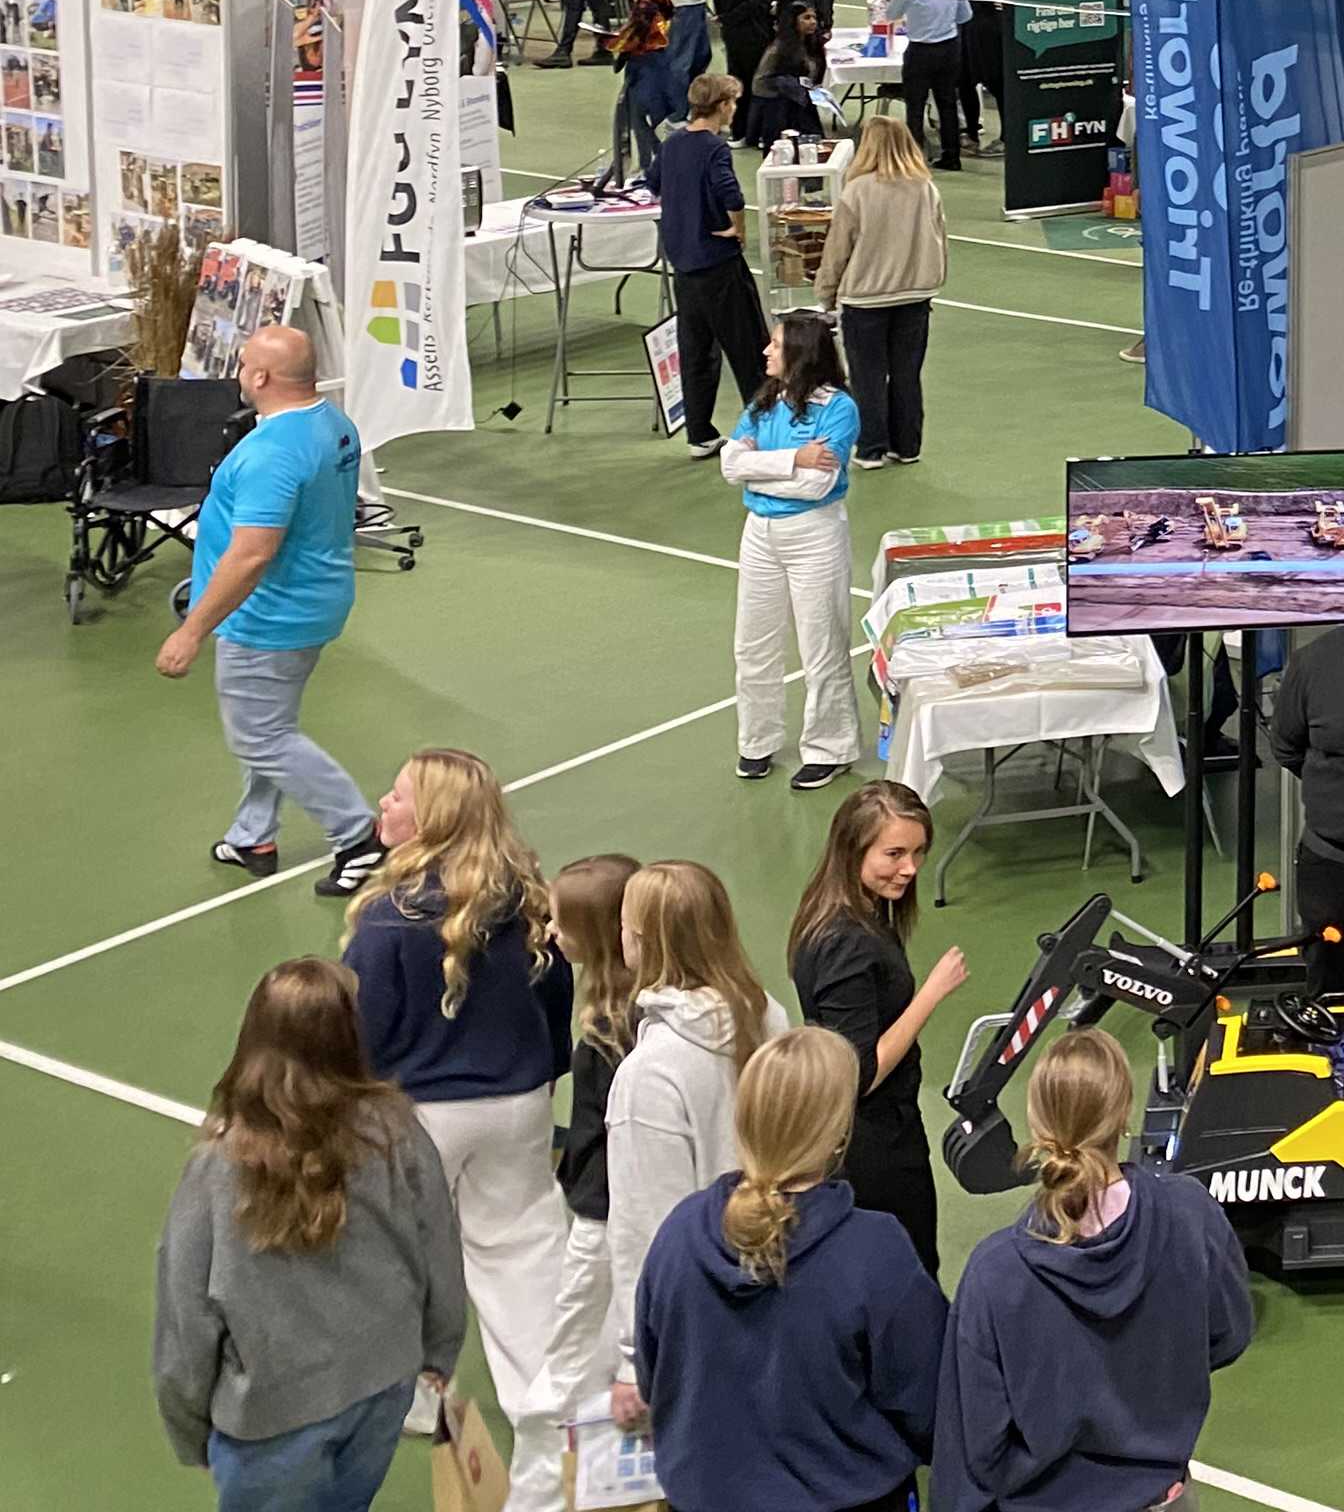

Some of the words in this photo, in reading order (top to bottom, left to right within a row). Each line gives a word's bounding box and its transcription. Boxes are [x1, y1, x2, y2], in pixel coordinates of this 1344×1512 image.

[419, 56, 444, 121] Nyborg
[1031, 120, 1068, 142] FH
[1074, 120, 1107, 135] FYN
[1102, 968, 1174, 1006] VOLVO
[1208, 1165, 1327, 1203] MUNCK
